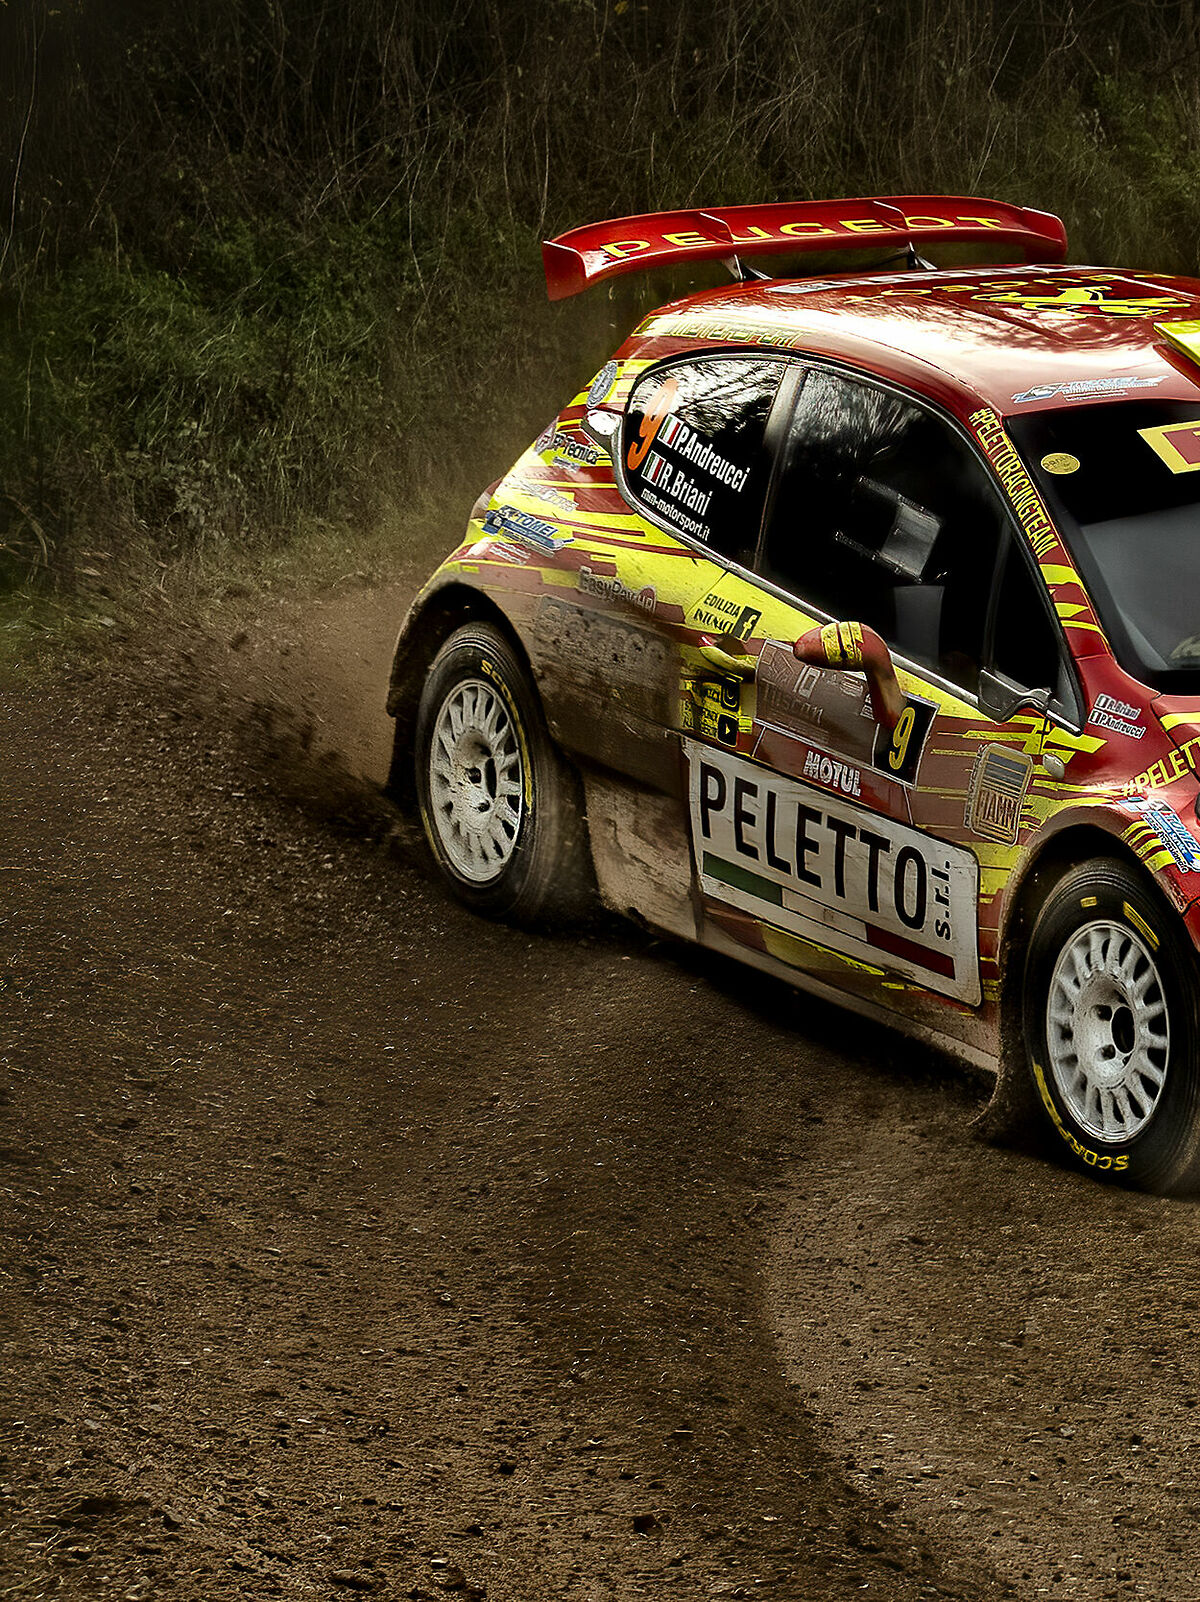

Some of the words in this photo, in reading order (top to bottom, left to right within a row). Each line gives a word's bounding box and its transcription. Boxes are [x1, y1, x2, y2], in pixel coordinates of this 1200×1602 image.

[603, 216, 1001, 258] PEUGEOT
[627, 378, 679, 471] 9
[674, 426, 750, 493] P.Andreucci
[968, 407, 1059, 560] #PELETTORACINGTEAM
[659, 464, 713, 516] R.Briani
[515, 513, 558, 537] TOMEI
[703, 593, 741, 618] EDILIZIA
[889, 707, 916, 769] 9
[803, 750, 861, 797] MOTUL
[701, 761, 928, 932] PELETTO
